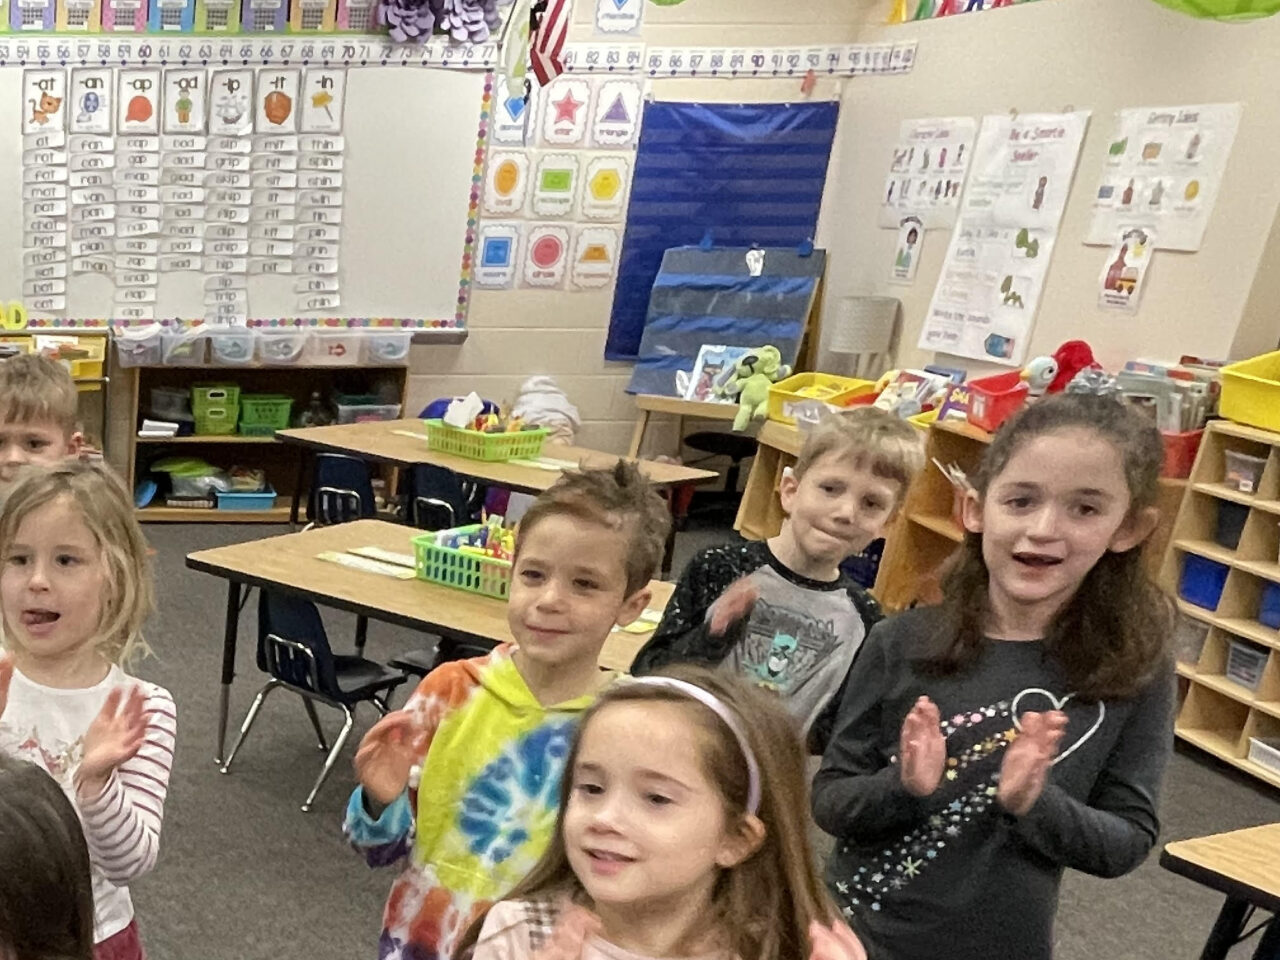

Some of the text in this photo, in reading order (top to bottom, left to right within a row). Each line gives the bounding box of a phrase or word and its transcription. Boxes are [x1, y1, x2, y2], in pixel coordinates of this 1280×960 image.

[32, 77, 56, 92] -at
[79, 78, 104, 89] -an
[127, 79, 152, 92] -ap
[173, 75, 198, 88] -ad
